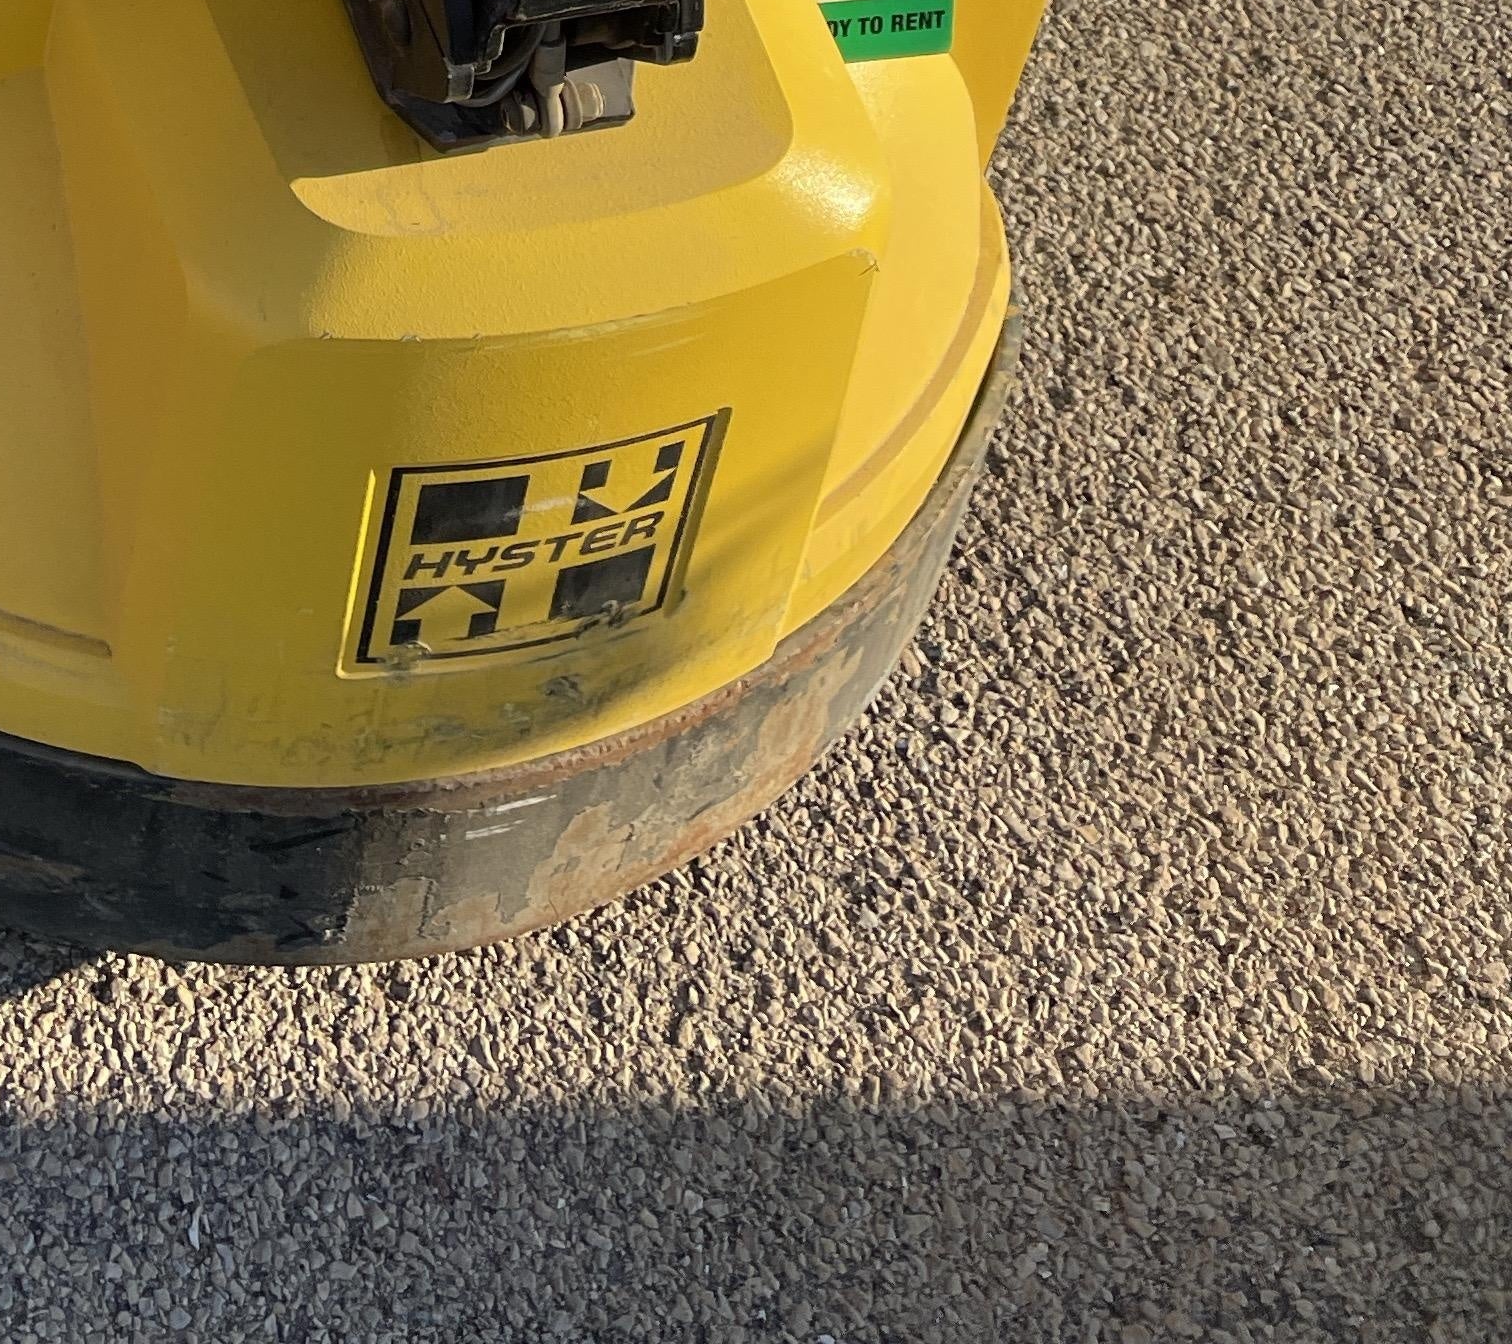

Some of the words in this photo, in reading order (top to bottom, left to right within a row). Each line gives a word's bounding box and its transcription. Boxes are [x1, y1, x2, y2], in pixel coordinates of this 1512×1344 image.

[858, 16, 883, 35] TO
[891, 10, 946, 32] RENT
[403, 510, 666, 581] HYSTER
